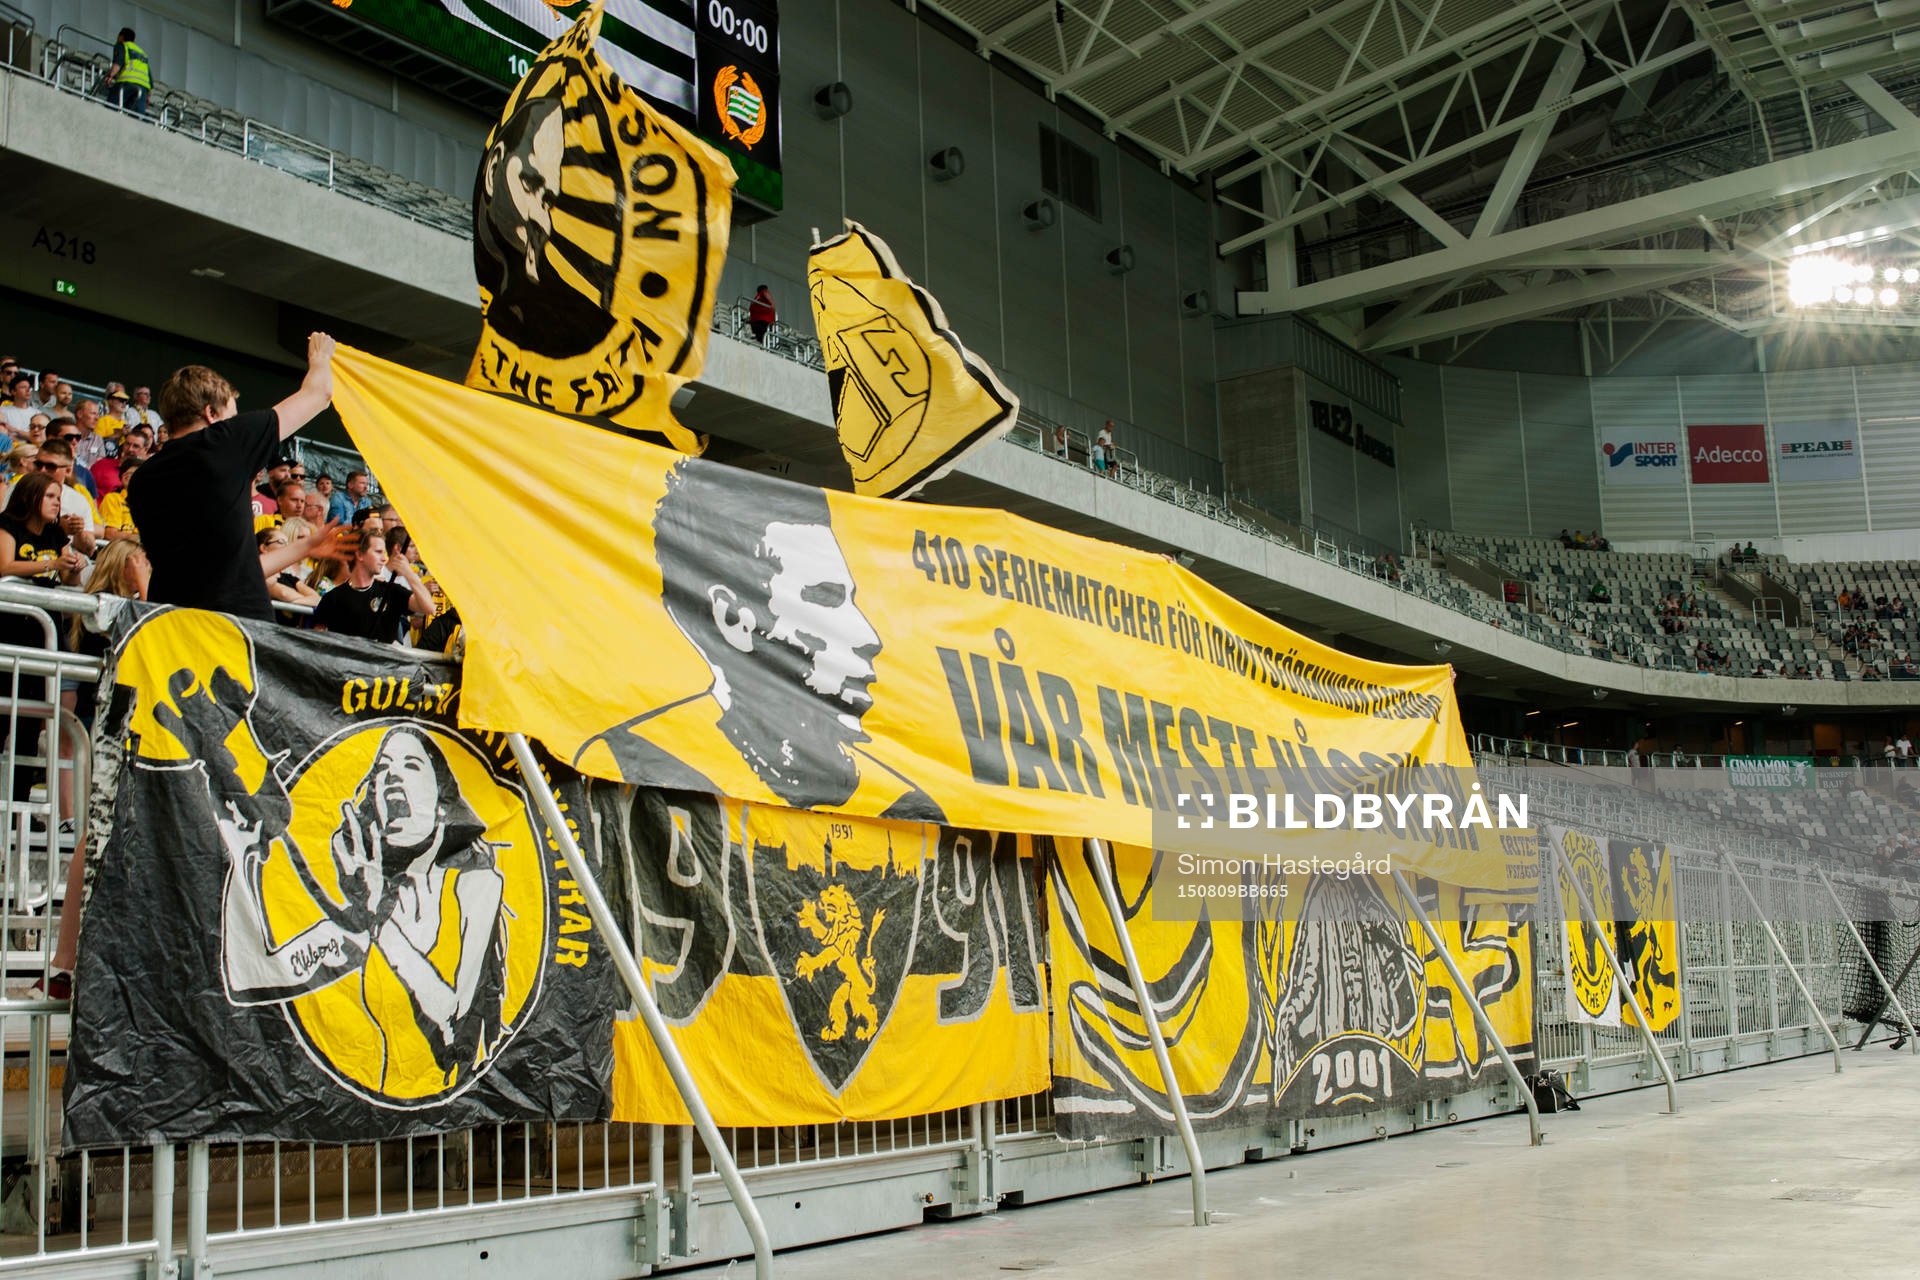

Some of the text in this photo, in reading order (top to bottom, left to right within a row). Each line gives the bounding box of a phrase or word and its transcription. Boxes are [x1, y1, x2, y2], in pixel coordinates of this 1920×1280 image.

[708, 0, 768, 54] 00:00
[31, 225, 96, 265] A218
[490, 340, 556, 409] THE
[1634, 442, 1677, 455] INTER
[1694, 445, 1763, 464] Adecco
[1790, 440, 1845, 453] PEAB
[1634, 454, 1678, 467] SPORT
[911, 529, 970, 590] 410
[973, 544, 1165, 646] SERIEMATCHER
[1166, 601, 1205, 660] FÖR
[1204, 621, 1370, 715] IDROTTSFÖRENINGEN
[935, 627, 1106, 799] VÅR
[1096, 684, 1286, 828] MESTE
[1729, 758, 1791, 774] CINNAMON
[1731, 773, 1792, 787] BROTHERS
[831, 823, 854, 840] 1991
[1585, 987, 1600, 1009] THE
[1312, 1047, 1393, 1105] 2001
